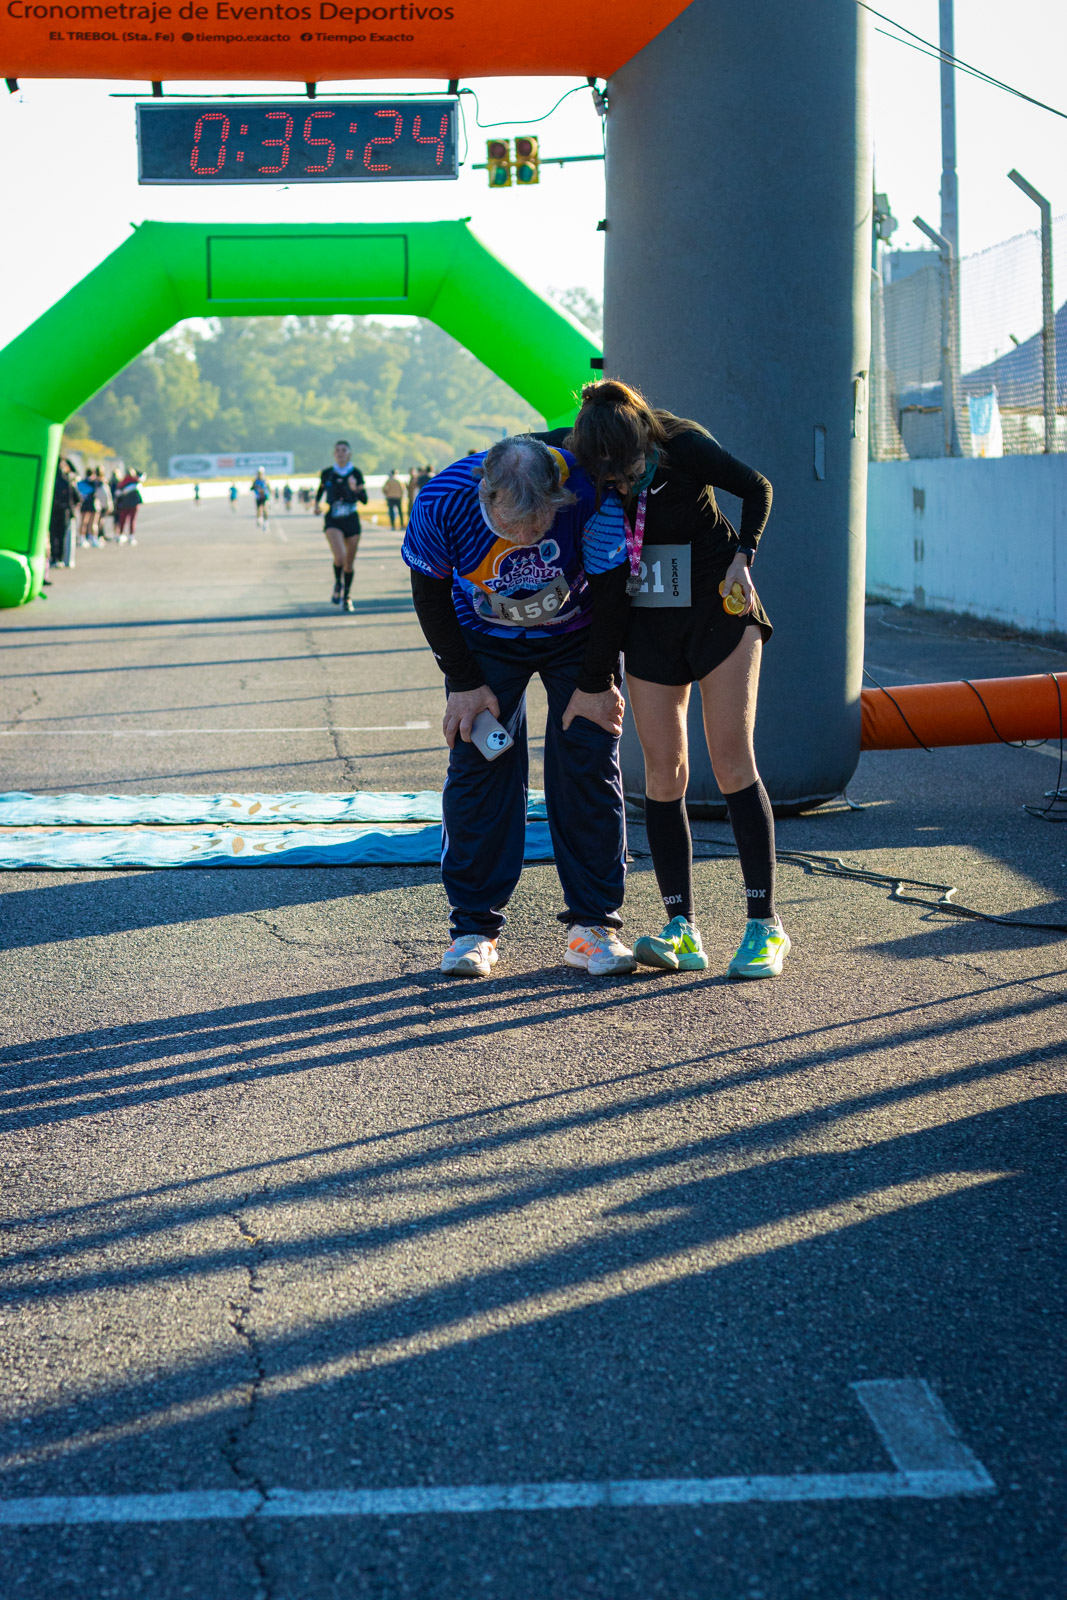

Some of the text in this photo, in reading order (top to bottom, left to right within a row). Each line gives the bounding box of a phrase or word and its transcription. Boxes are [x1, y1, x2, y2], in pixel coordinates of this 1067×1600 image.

[7, 1, 454, 24] Cronometraje de Eventos Deportivos
[50, 32, 175, 42] EL TREBOL (Sta. Fe)
[196, 32, 291, 44] tiempo.exacto
[315, 33, 414, 44] Tiempo Exacto
[190, 110, 448, 174] 0:35:24
[543, 545, 552, 557] 4
[671, 558, 680, 597] EXACTO
[508, 593, 559, 621] 156
[663, 894, 683, 905] SOX
[746, 889, 766, 898] SOX
